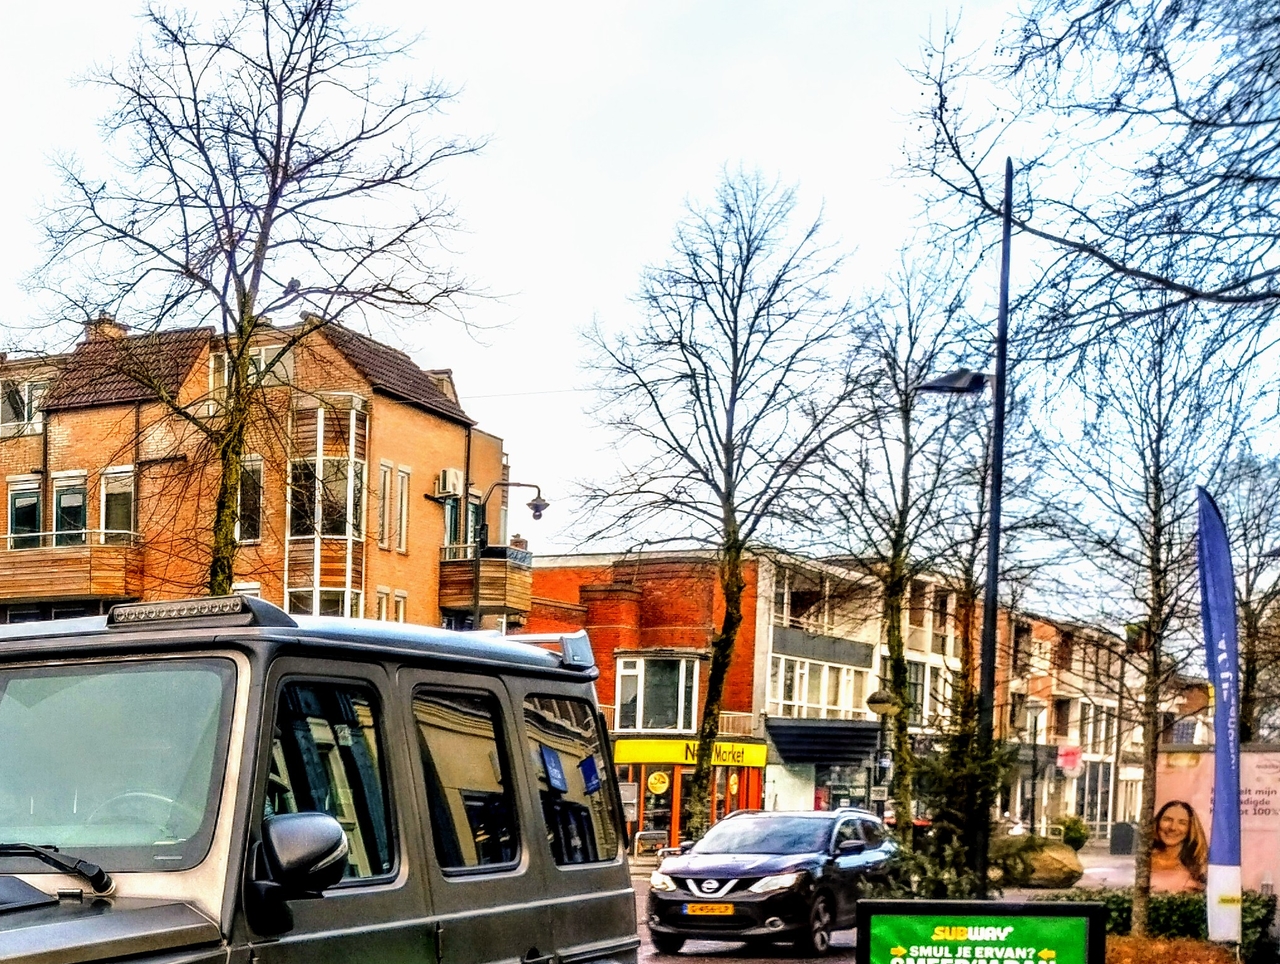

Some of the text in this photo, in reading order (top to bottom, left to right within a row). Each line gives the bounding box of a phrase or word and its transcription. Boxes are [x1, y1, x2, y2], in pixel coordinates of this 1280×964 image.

[714, 744, 745, 763] Market
[931, 926, 1014, 942] SUBWAY
[909, 946, 1036, 960] SMUL JE ERVAN?
